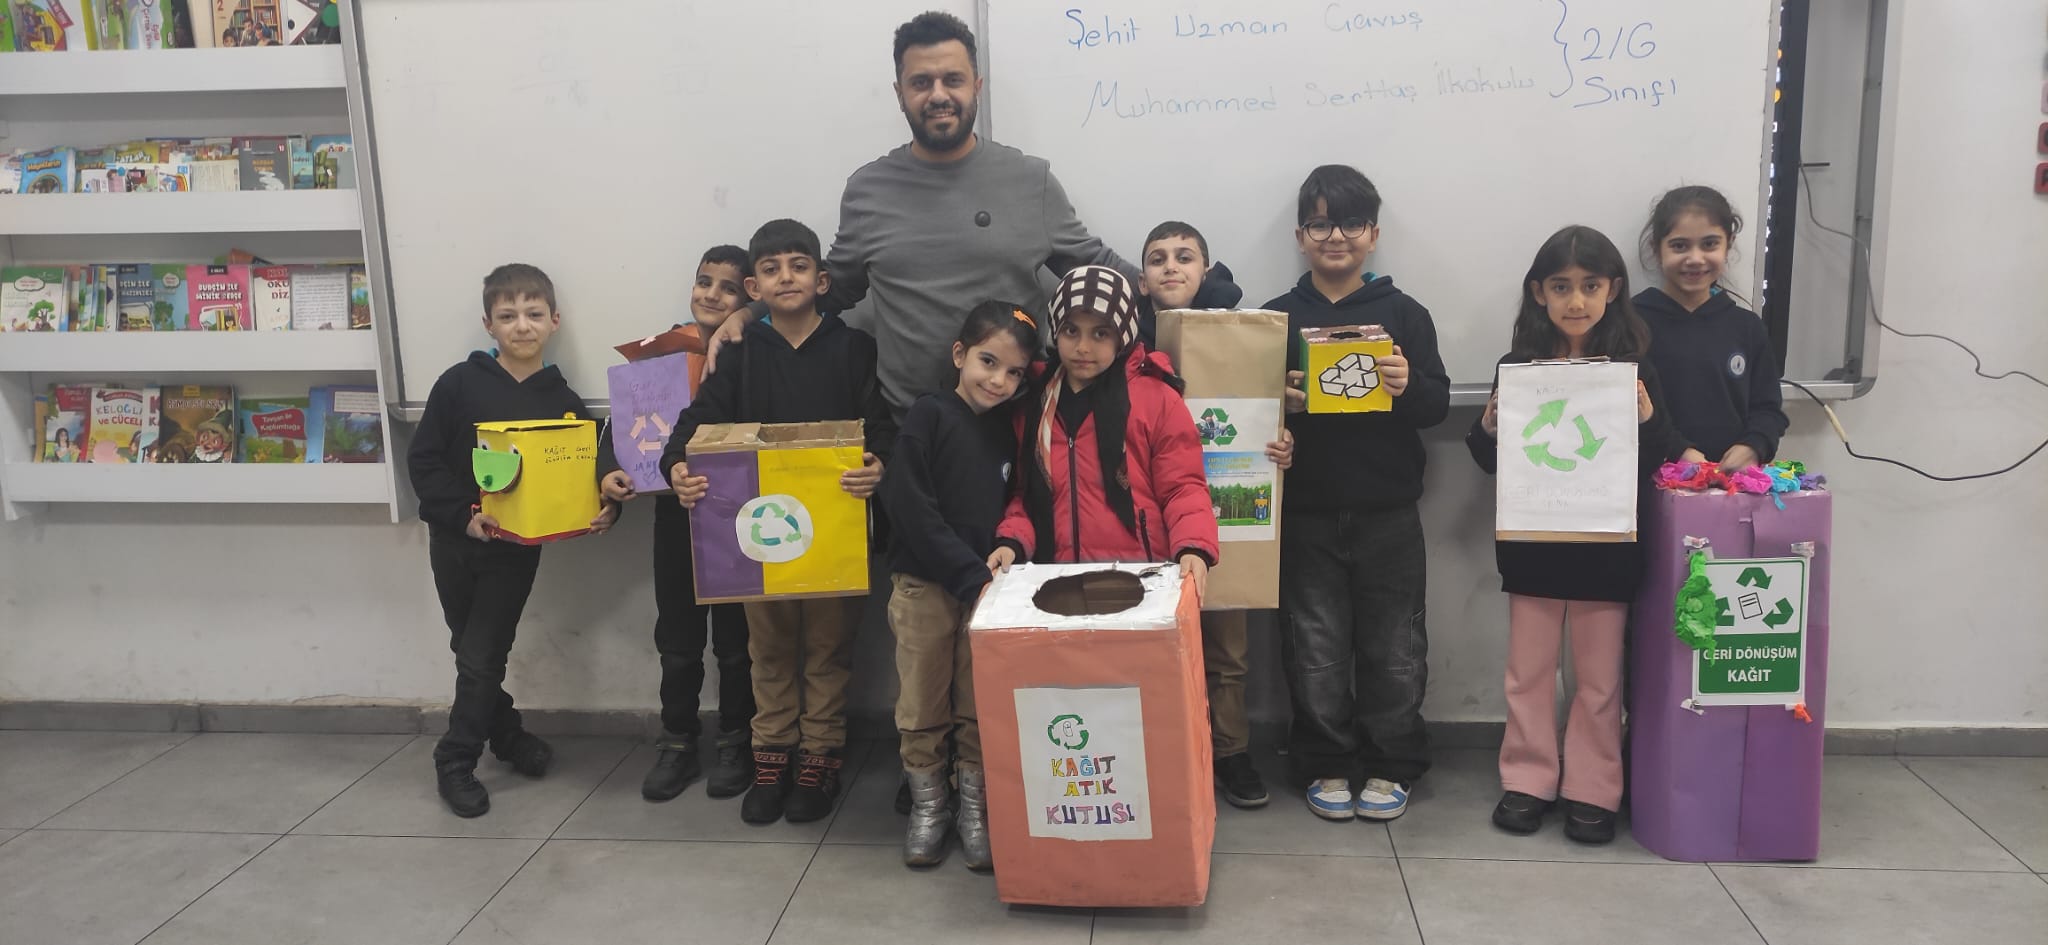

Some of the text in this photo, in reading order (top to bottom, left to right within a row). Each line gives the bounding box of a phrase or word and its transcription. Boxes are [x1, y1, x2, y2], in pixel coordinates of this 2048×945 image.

[1065, 9, 1142, 50] Şehit
[1174, 13, 1289, 39] Uzman
[1579, 22, 1656, 61] 2/G
[1081, 79, 1278, 128] Muhammed
[1735, 645, 1797, 661] DÖNÜŞÜM
[1727, 667, 1772, 683] KAĞIT
[1051, 755, 1116, 777] KAĞIT
[1064, 777, 1117, 797] ATIK
